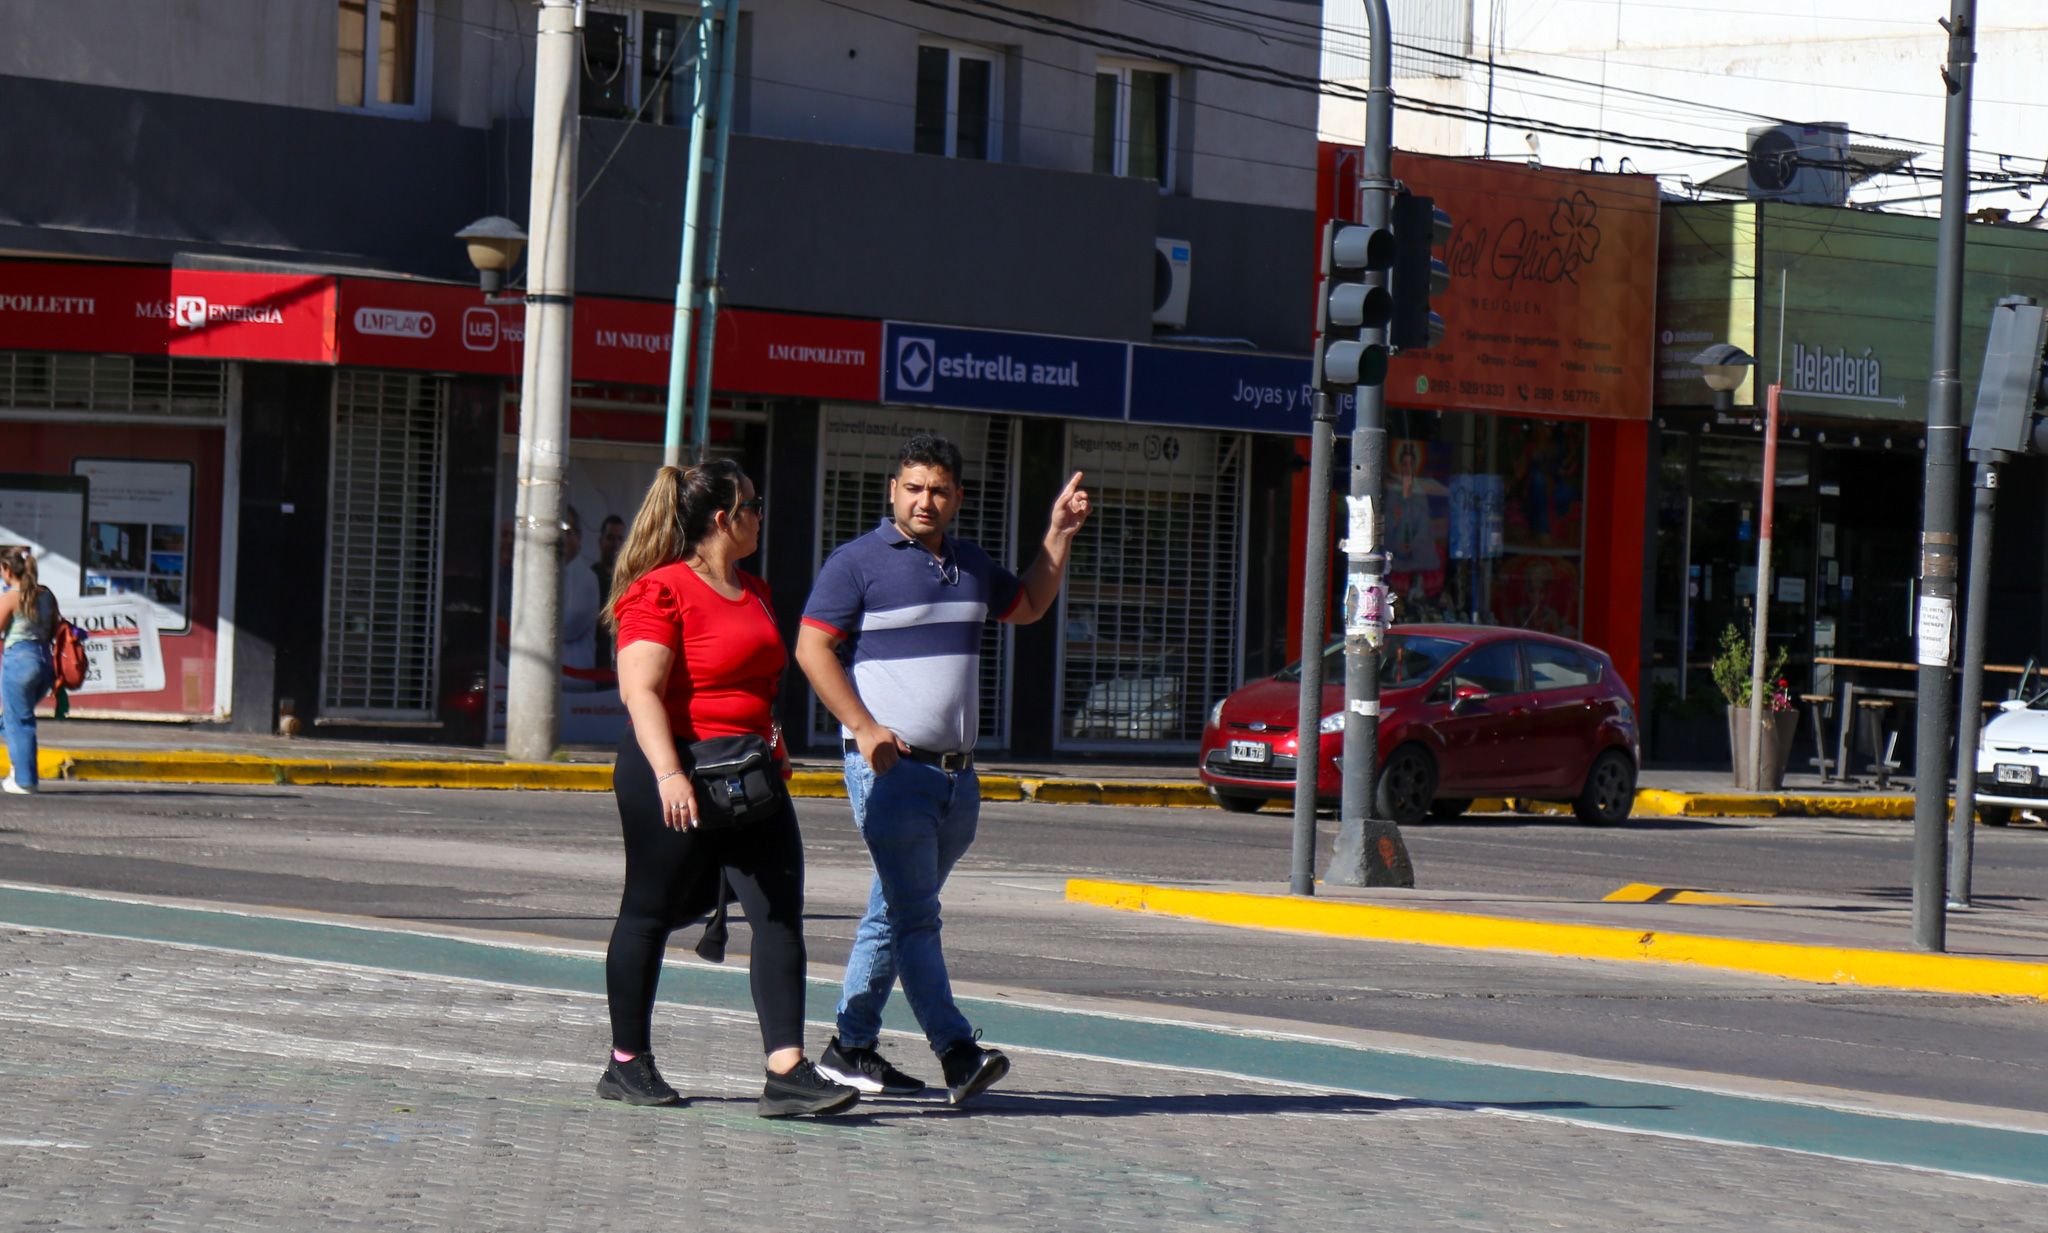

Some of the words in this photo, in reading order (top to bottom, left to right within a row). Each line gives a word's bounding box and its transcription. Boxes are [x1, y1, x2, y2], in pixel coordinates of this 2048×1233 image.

[135, 300, 175, 320] MÁS
[208, 303, 283, 324] ENERGÍA
[938, 352, 1026, 383] estrella
[1032, 361, 1079, 387] azul
[1792, 344, 1881, 396] Heladería
[1233, 379, 1282, 409] Joyas
[1287, 389, 1297, 411] y
